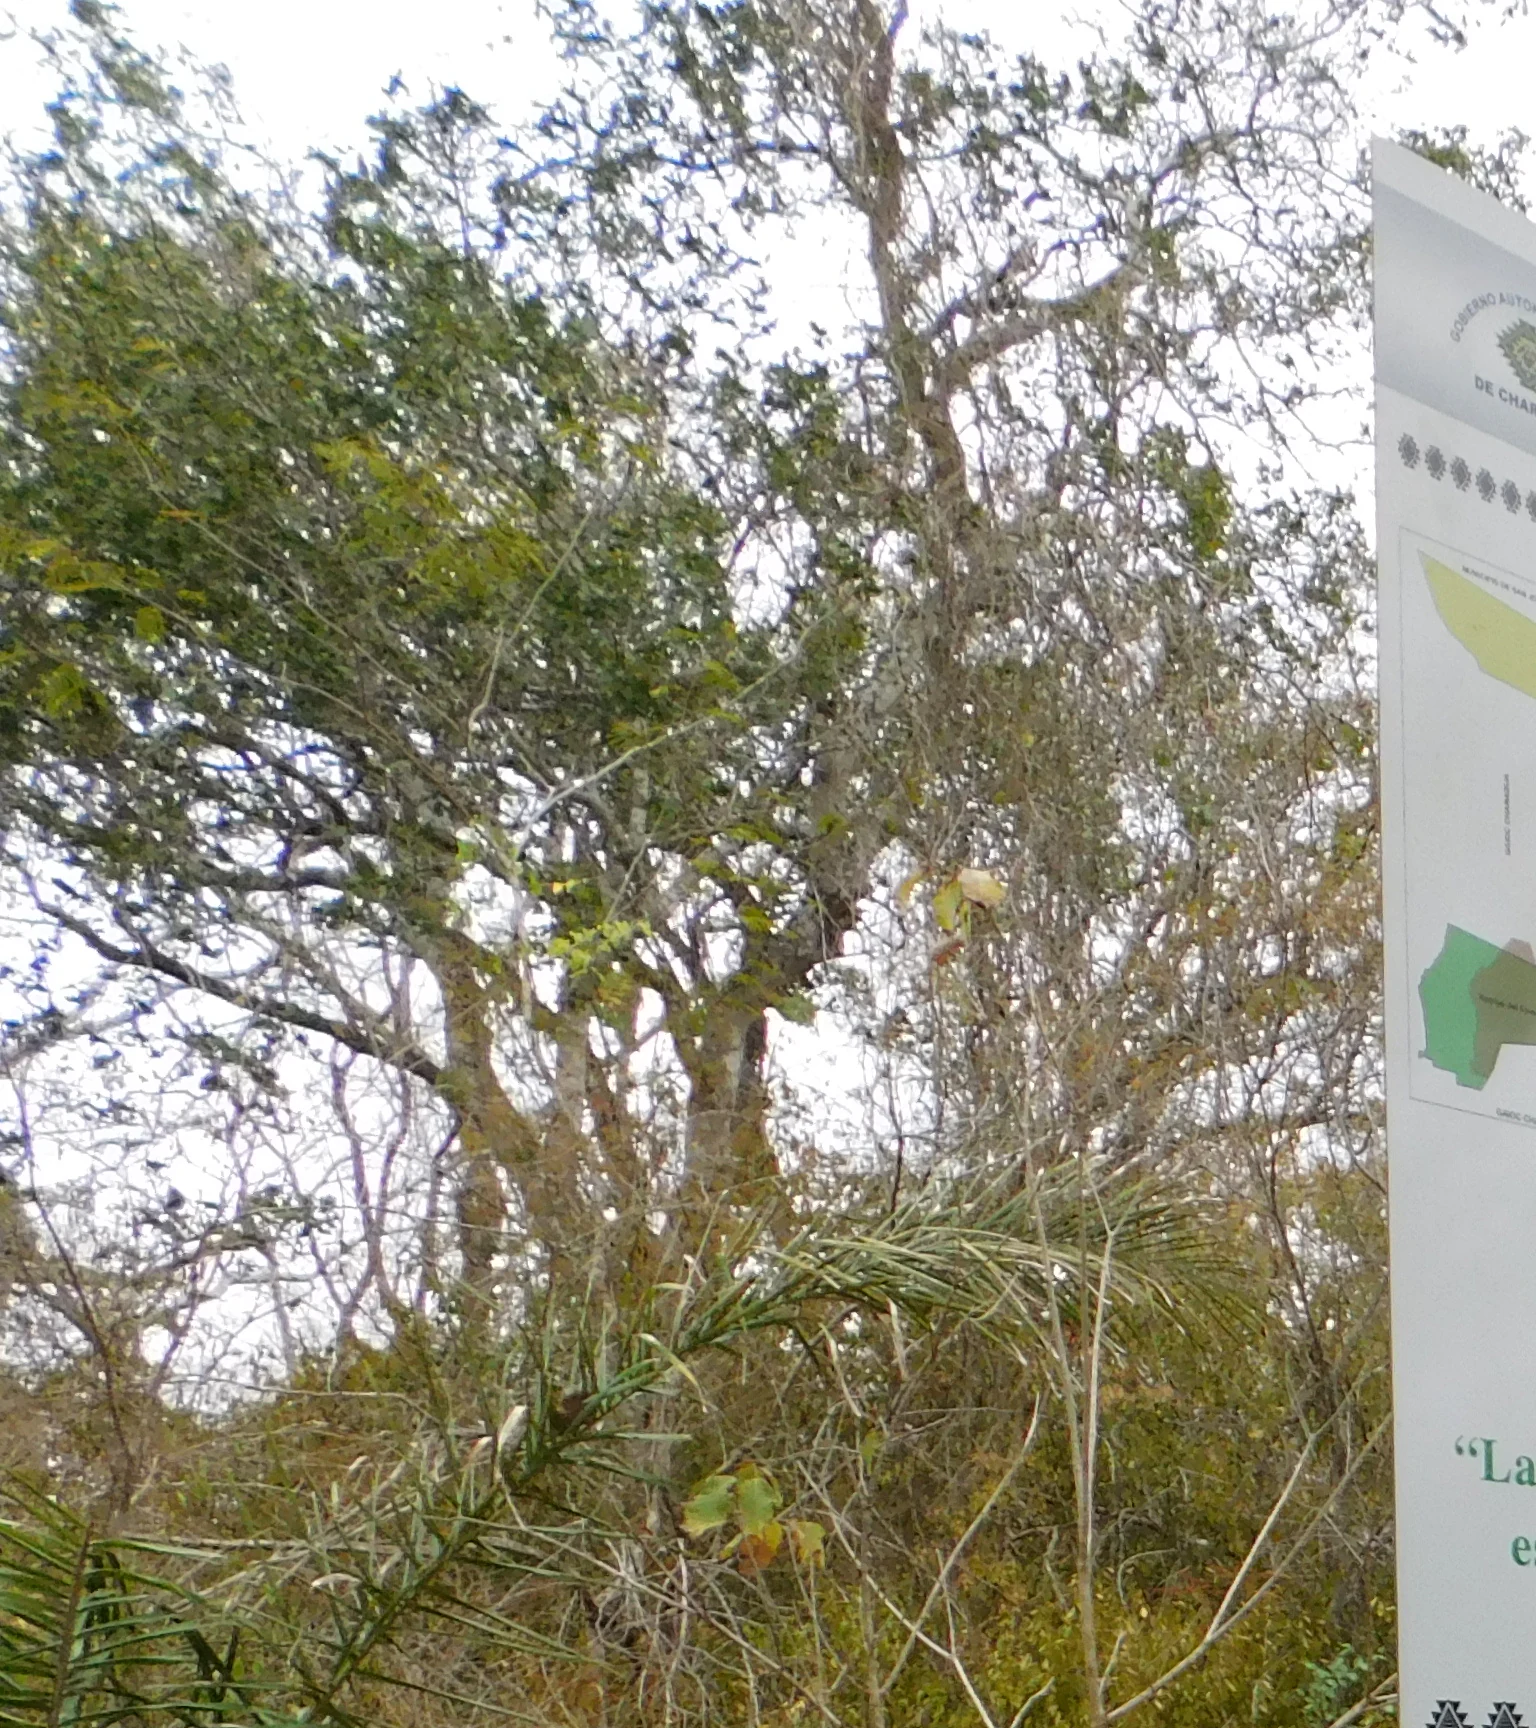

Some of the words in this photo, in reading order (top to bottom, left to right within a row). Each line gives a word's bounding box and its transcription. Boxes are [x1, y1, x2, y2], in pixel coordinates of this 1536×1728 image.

[1450, 292, 1496, 342] GOBIERNO
[1475, 374, 1494, 397] DE
[1454, 1435, 1536, 1487] “La
